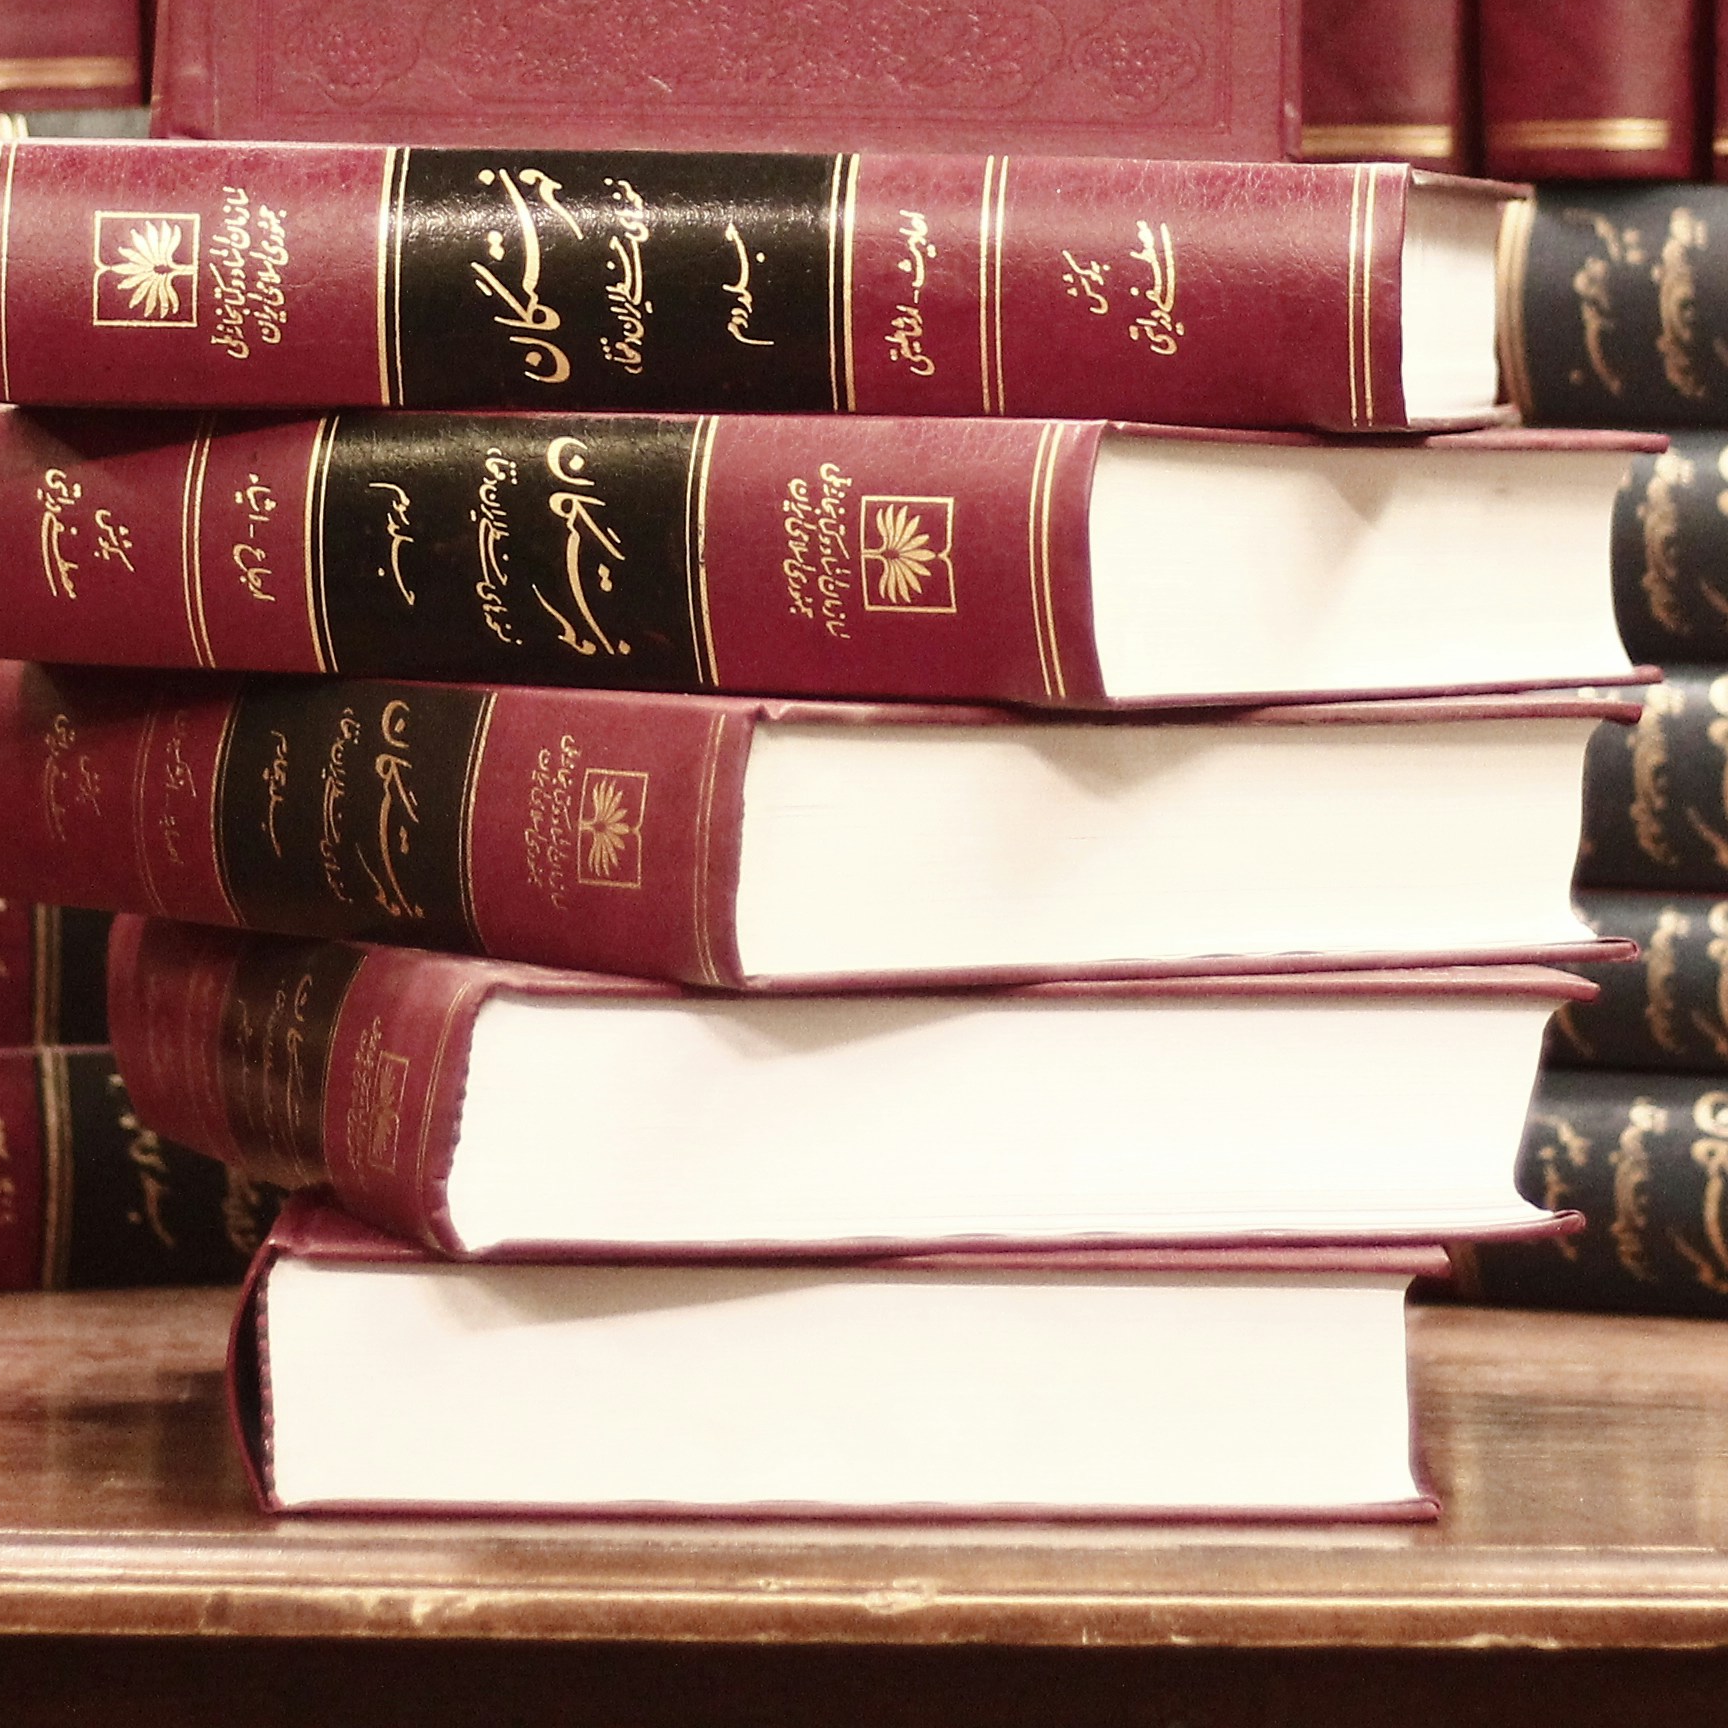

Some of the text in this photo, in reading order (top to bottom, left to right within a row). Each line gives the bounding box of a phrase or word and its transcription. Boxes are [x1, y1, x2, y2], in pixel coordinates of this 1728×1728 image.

[246, 204, 289, 344] جمهوری اسلامی ایران
[471, 167, 583, 384] فهرستگان
[722, 222, 776, 347] جلد دوم
[368, 480, 416, 606] جلد سوم
[531, 435, 632, 657] فهرستگان
[783, 478, 818, 619] جمهوری اسلامی ایران
[355, 699, 426, 920] فهرستگان
